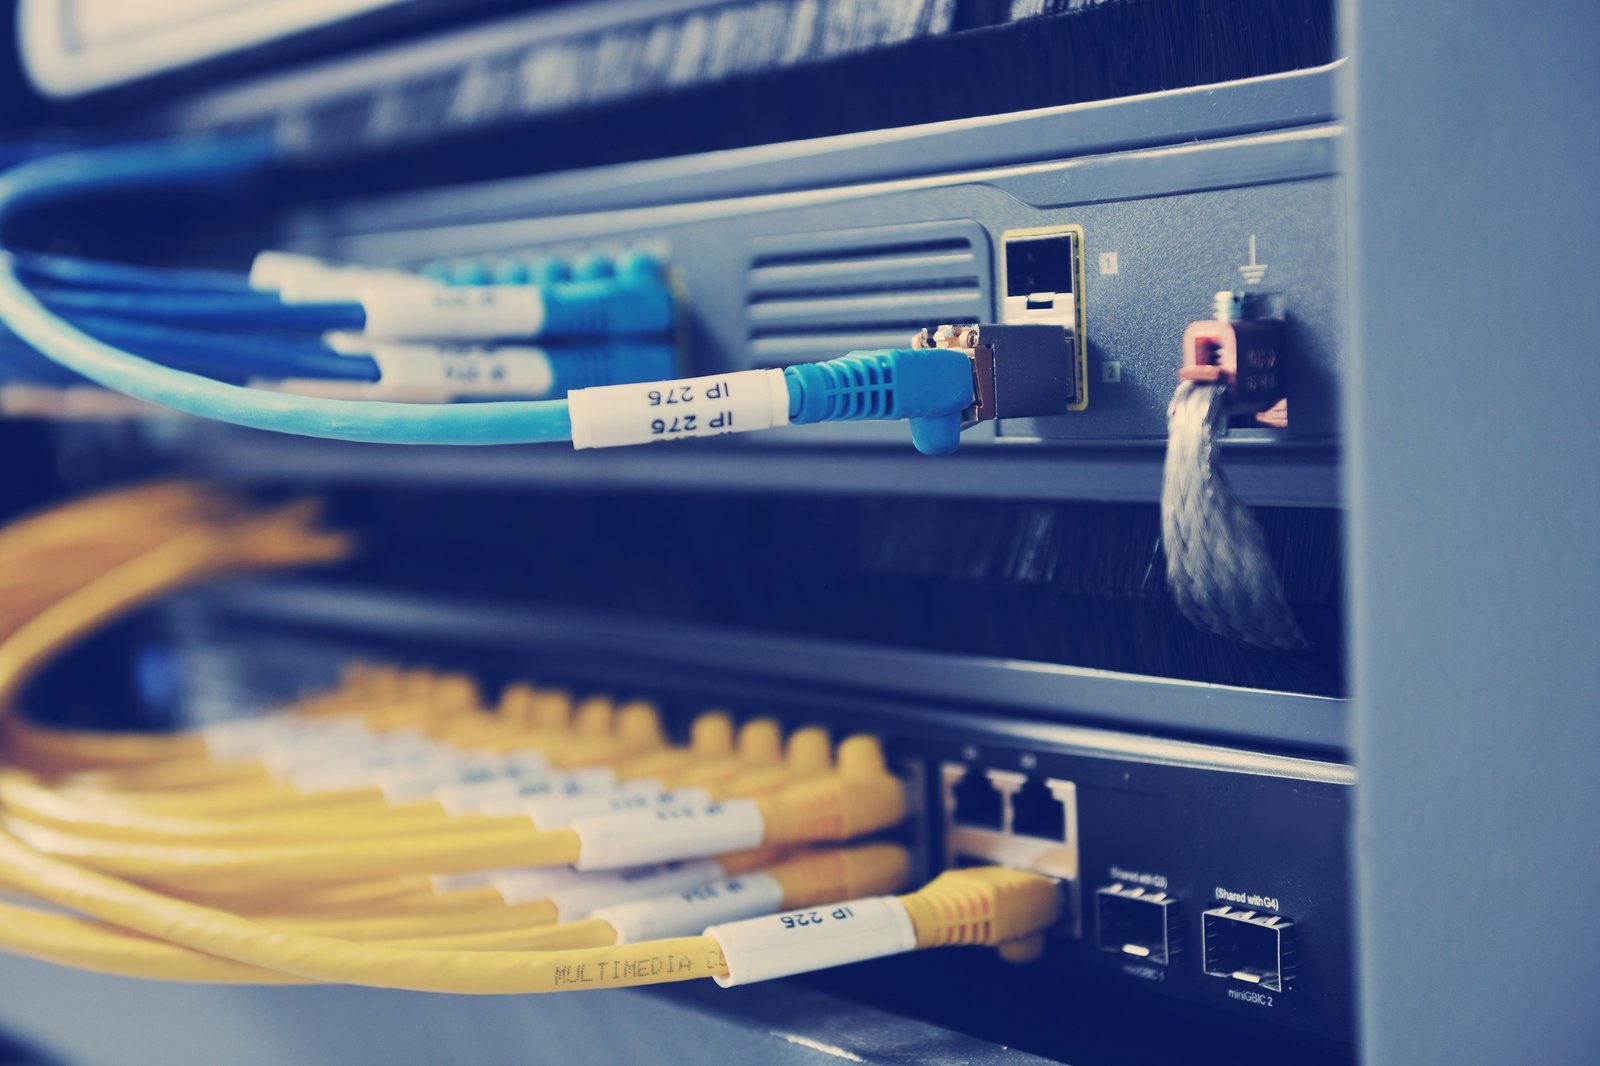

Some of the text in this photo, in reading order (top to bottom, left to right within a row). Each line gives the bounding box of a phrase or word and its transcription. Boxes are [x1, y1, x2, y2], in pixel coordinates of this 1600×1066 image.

[648, 382, 729, 406] IP 275
[651, 411, 732, 434] IP 275
[1215, 886, 1279, 911] (Shared with G4)
[780, 906, 854, 929] IP 225
[555, 953, 692, 986] MULTIMEDIA
[1228, 989, 1273, 1007] miniGBIC 2
